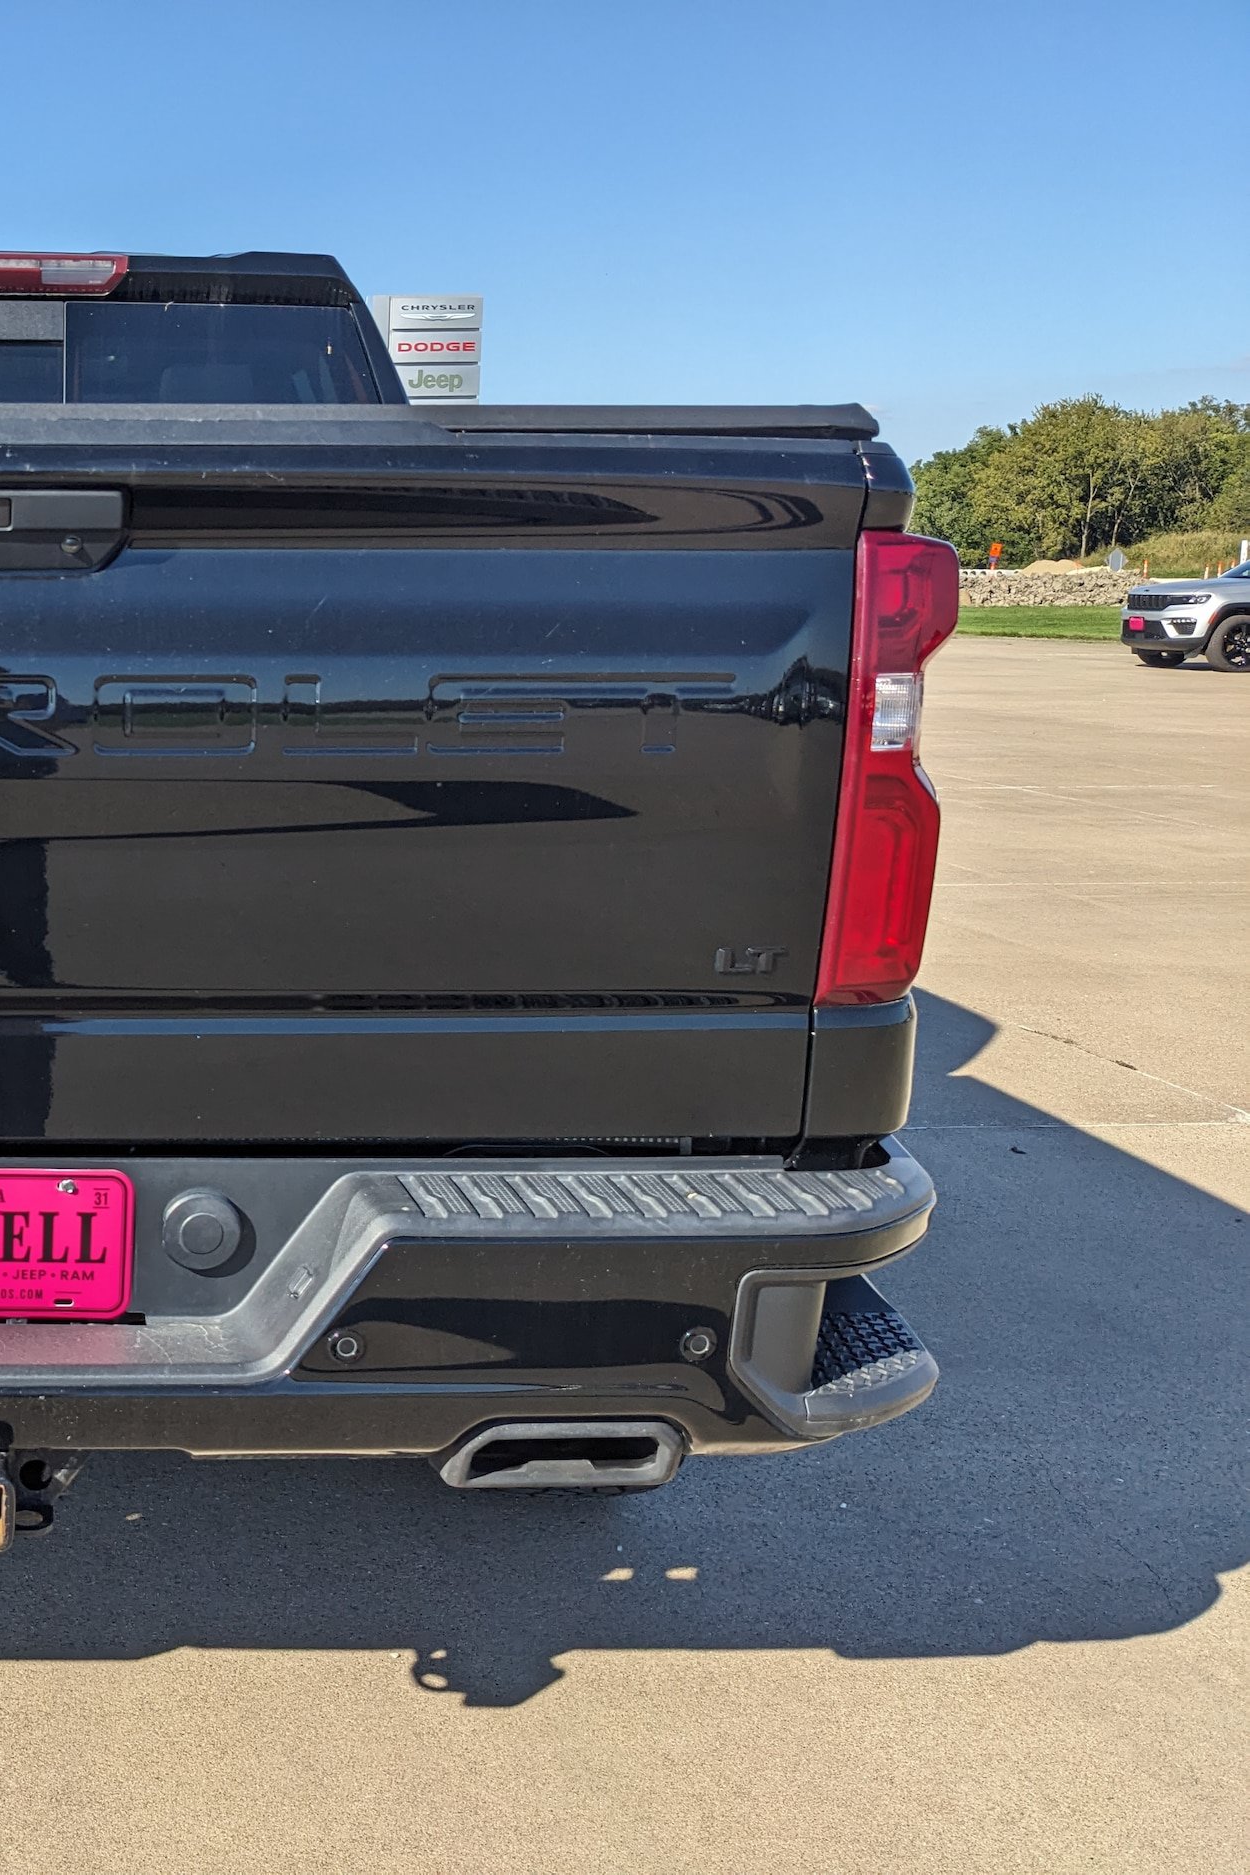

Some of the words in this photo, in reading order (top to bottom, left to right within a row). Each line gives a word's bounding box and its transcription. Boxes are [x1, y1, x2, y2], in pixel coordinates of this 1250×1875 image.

[398, 342, 475, 352] DODGE
[408, 369, 463, 392] Jeep
[714, 945, 787, 974] LT
[94, 1192, 109, 1206] 31
[12, 1269, 47, 1280] JEEP
[60, 1270, 95, 1281] RAM
